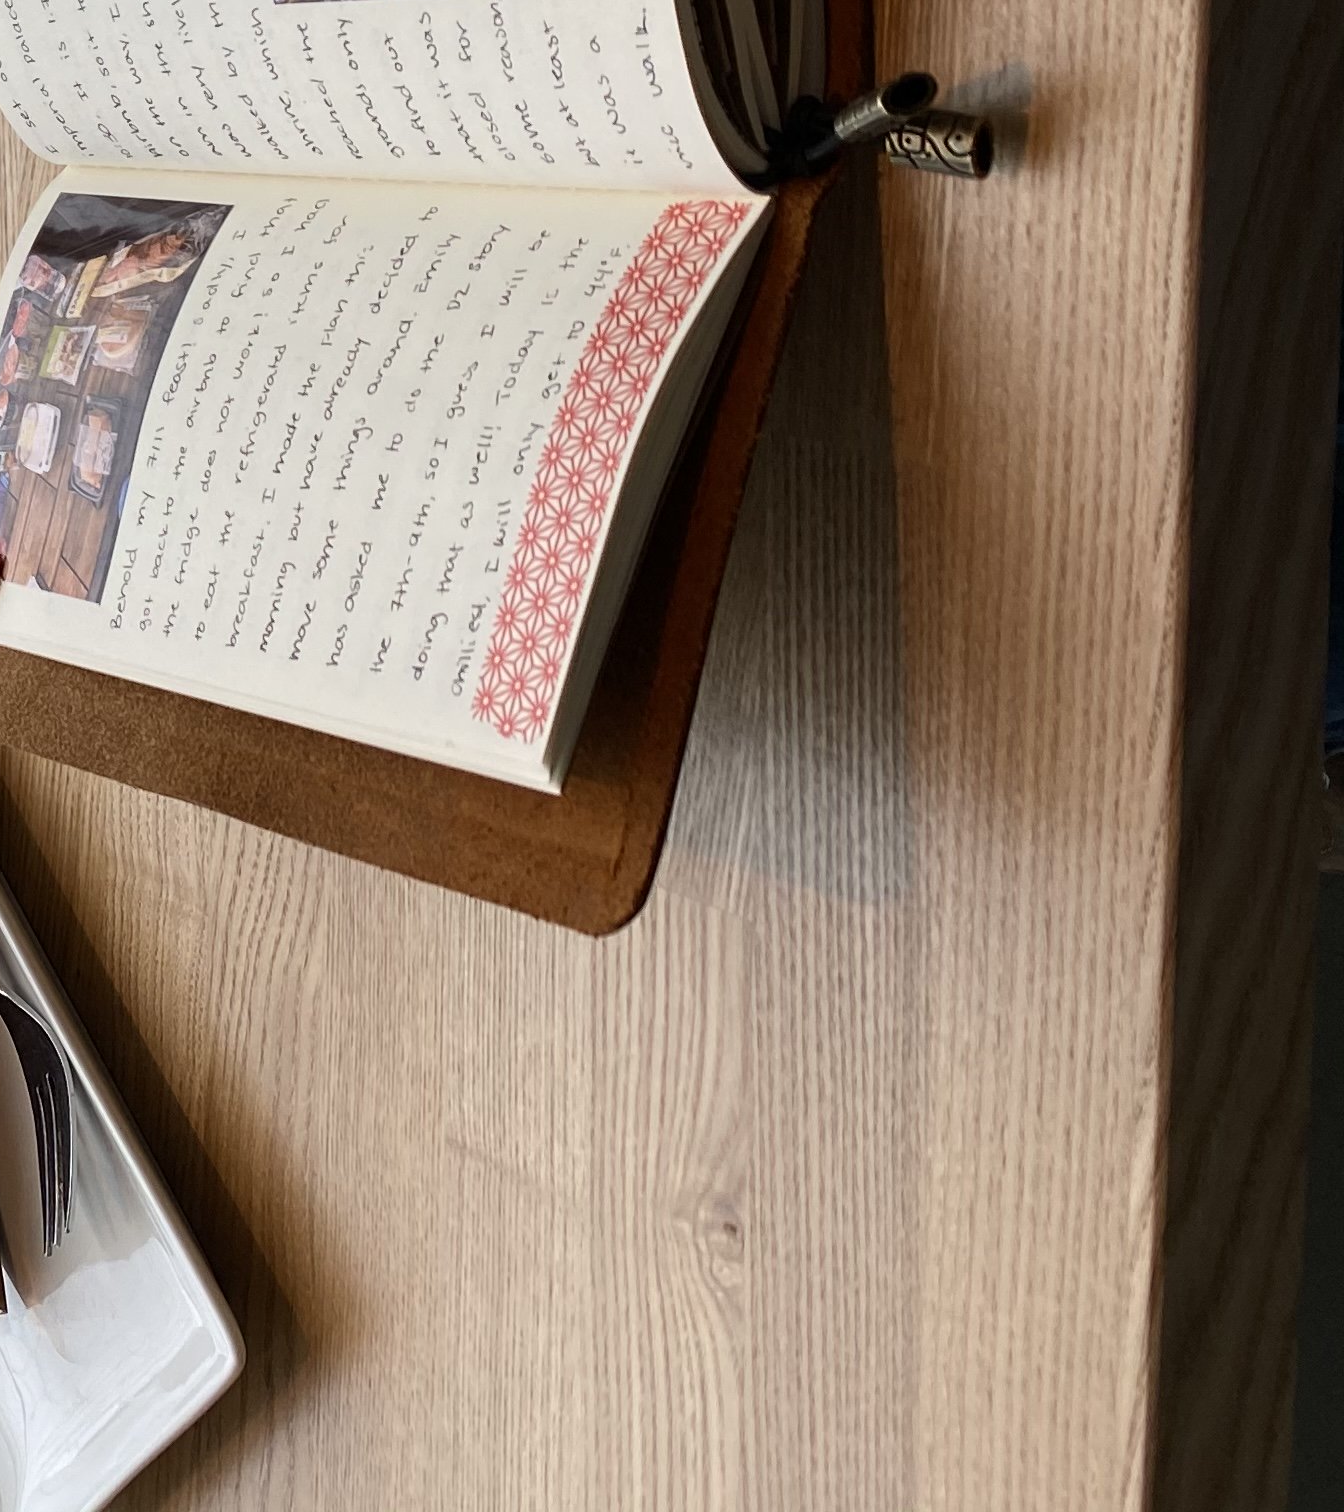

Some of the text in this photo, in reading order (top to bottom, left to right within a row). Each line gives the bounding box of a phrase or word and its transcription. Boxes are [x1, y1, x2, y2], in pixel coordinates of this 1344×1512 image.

[251, 8, 279, 80] which
[384, 32, 403, 72] out
[419, 12, 440, 68] was
[544, 19, 566, 89] least
[337, 19, 405, 158] grounds only
[437, 79, 451, 100] it
[558, 99, 579, 127] at
[231, 253, 261, 298] find
[216, 317, 230, 335] to
[163, 601, 179, 637] the
[174, 508, 200, 584] fridge
[200, 450, 216, 492] does
[216, 395, 234, 433] not
[233, 313, 268, 379] work!
[281, 246, 295, 256] I
[173, 447, 187, 480] the
[195, 622, 206, 641] to
[201, 564, 221, 609] eat
[219, 511, 235, 546] the
[235, 344, 286, 484] refrigerated
[323, 216, 347, 244] for
[260, 206, 439, 653] morning but have already decided to
[262, 488, 277, 503] I
[272, 411, 302, 476] made
[298, 363, 321, 396] the
[289, 601, 316, 661] move
[312, 520, 338, 580] some
[333, 417, 373, 490] things
[413, 234, 461, 293] Emily
[369, 230, 550, 672] the so I guess I will be
[412, 237, 589, 681] doing that as well! Today the
[485, 320, 585, 573] I will only get to
[158, 496, 175, 516] to
[326, 623, 348, 666] has
[342, 541, 374, 613] asked
[371, 474, 389, 510] me
[385, 433, 403, 452] to
[420, 334, 444, 373] the
[110, 548, 138, 629] Behold
[137, 491, 155, 526] my
[150, 524, 169, 579] back
[140, 596, 153, 631] got
